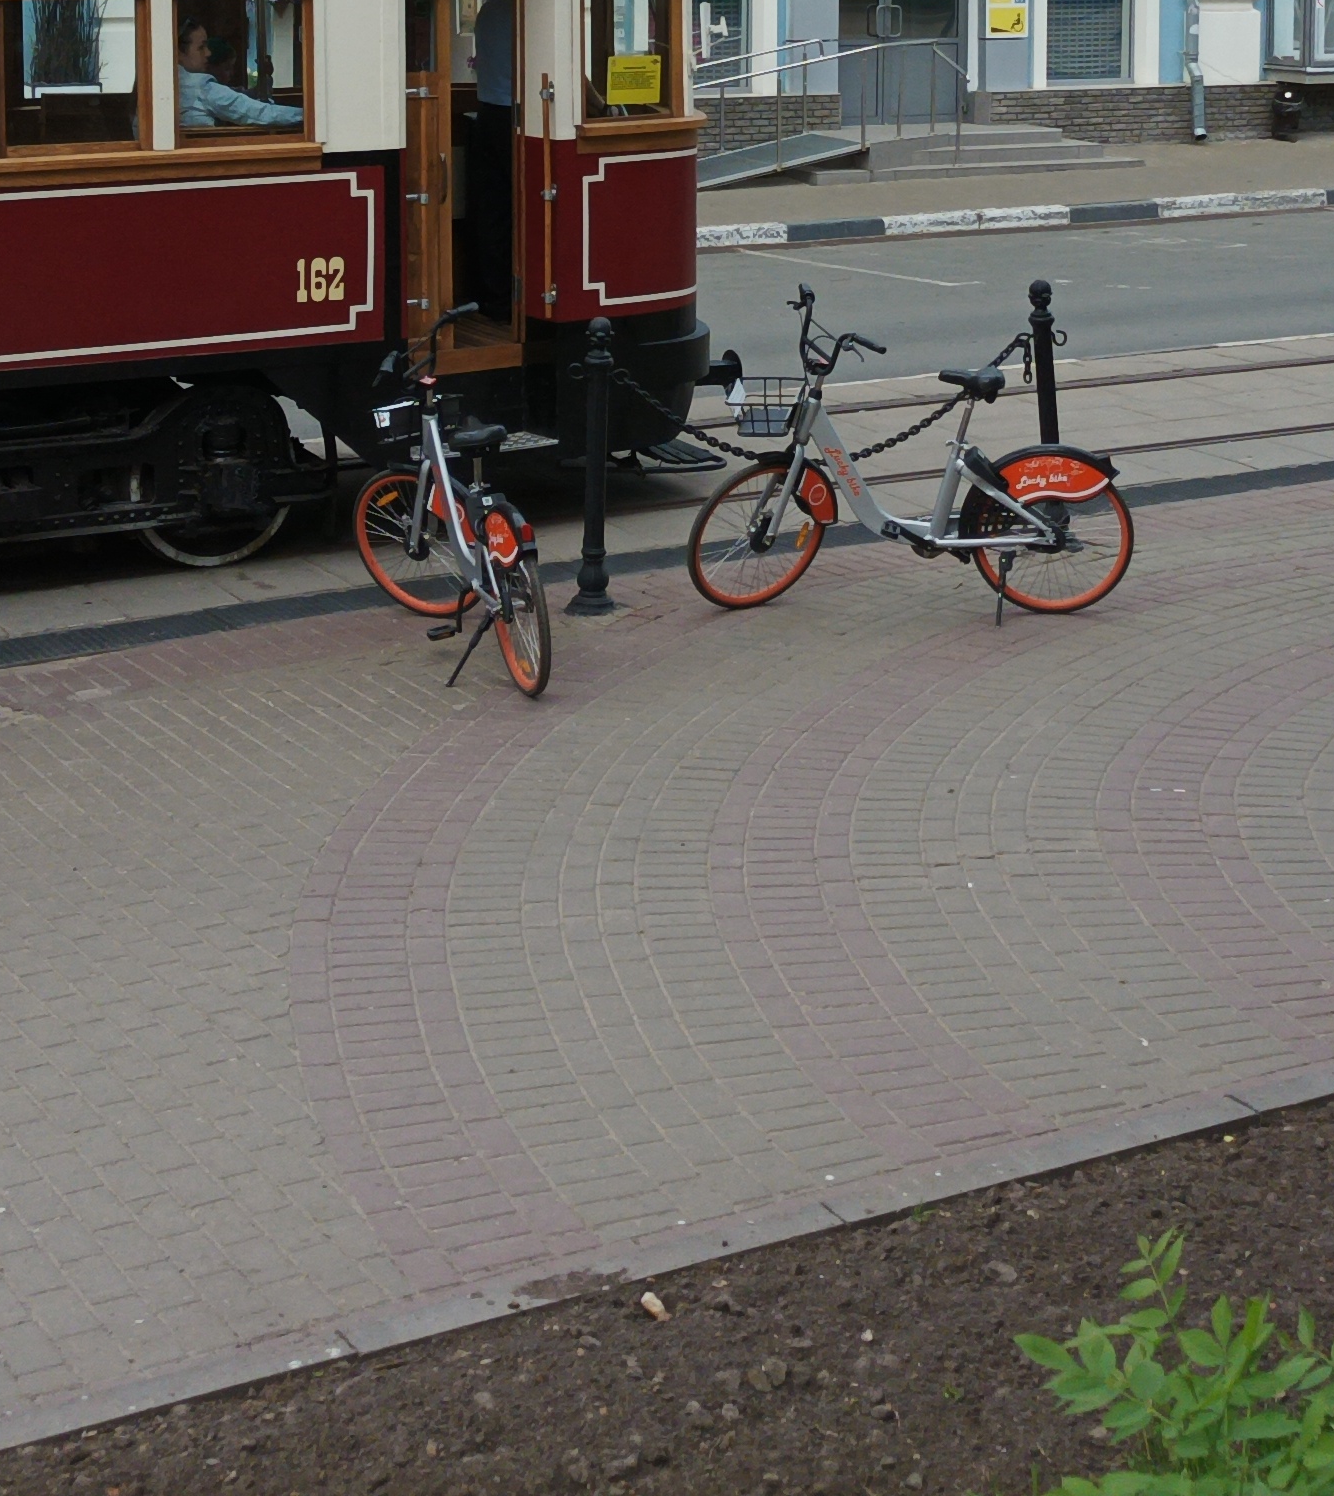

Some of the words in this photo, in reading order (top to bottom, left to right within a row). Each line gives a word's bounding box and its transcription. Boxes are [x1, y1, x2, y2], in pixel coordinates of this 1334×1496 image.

[296, 256, 345, 303] 162
[1015, 475, 1047, 490] Lucky
[1049, 472, 1068, 483] bike
